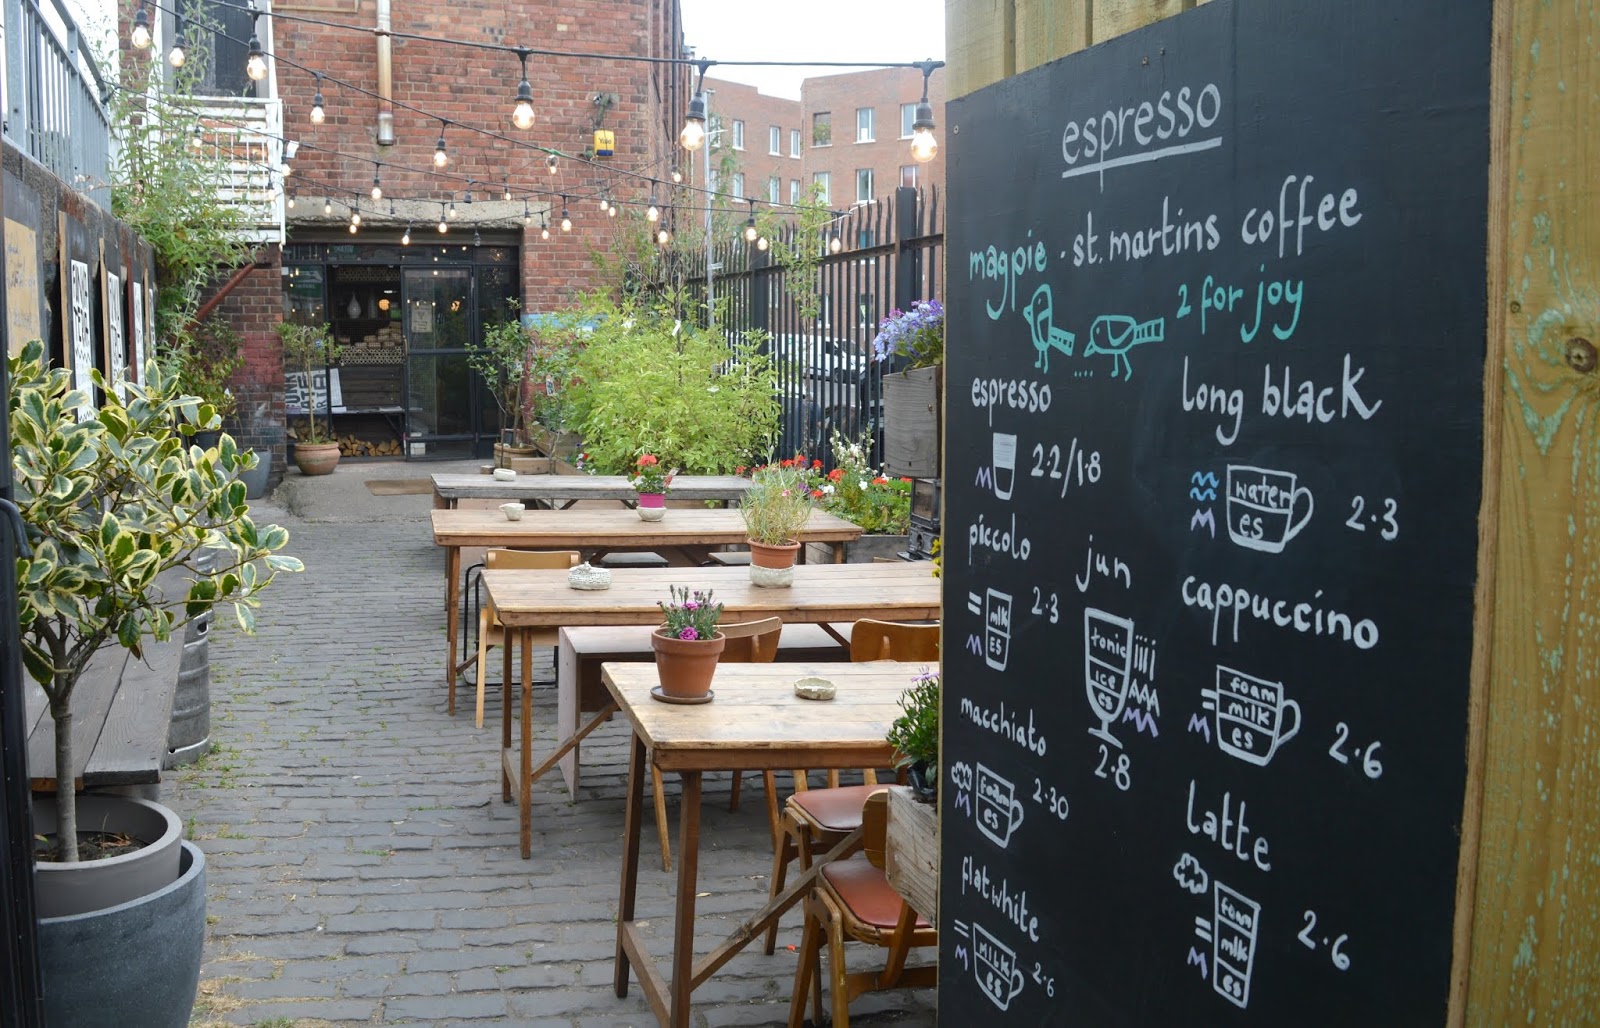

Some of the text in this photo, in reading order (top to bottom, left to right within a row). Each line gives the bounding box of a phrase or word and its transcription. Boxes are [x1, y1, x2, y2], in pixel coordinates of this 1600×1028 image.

[1062, 83, 1221, 192] espresso
[969, 230, 1047, 320] magpie
[1242, 175, 1363, 258] coffee
[1176, 264, 1303, 343] 2 for joy
[971, 377, 1051, 427] espresso
[1182, 353, 1382, 446] long black
[1236, 475, 1291, 509] water
[968, 513, 1030, 566] piccolo
[1076, 534, 1131, 593] jun
[1182, 575, 1379, 649] cappuccino
[1091, 627, 1127, 658] tonic
[1228, 699, 1271, 726] milk
[1230, 676, 1276, 703] foam
[961, 697, 1047, 757] macchiato
[1186, 779, 1272, 872] latte
